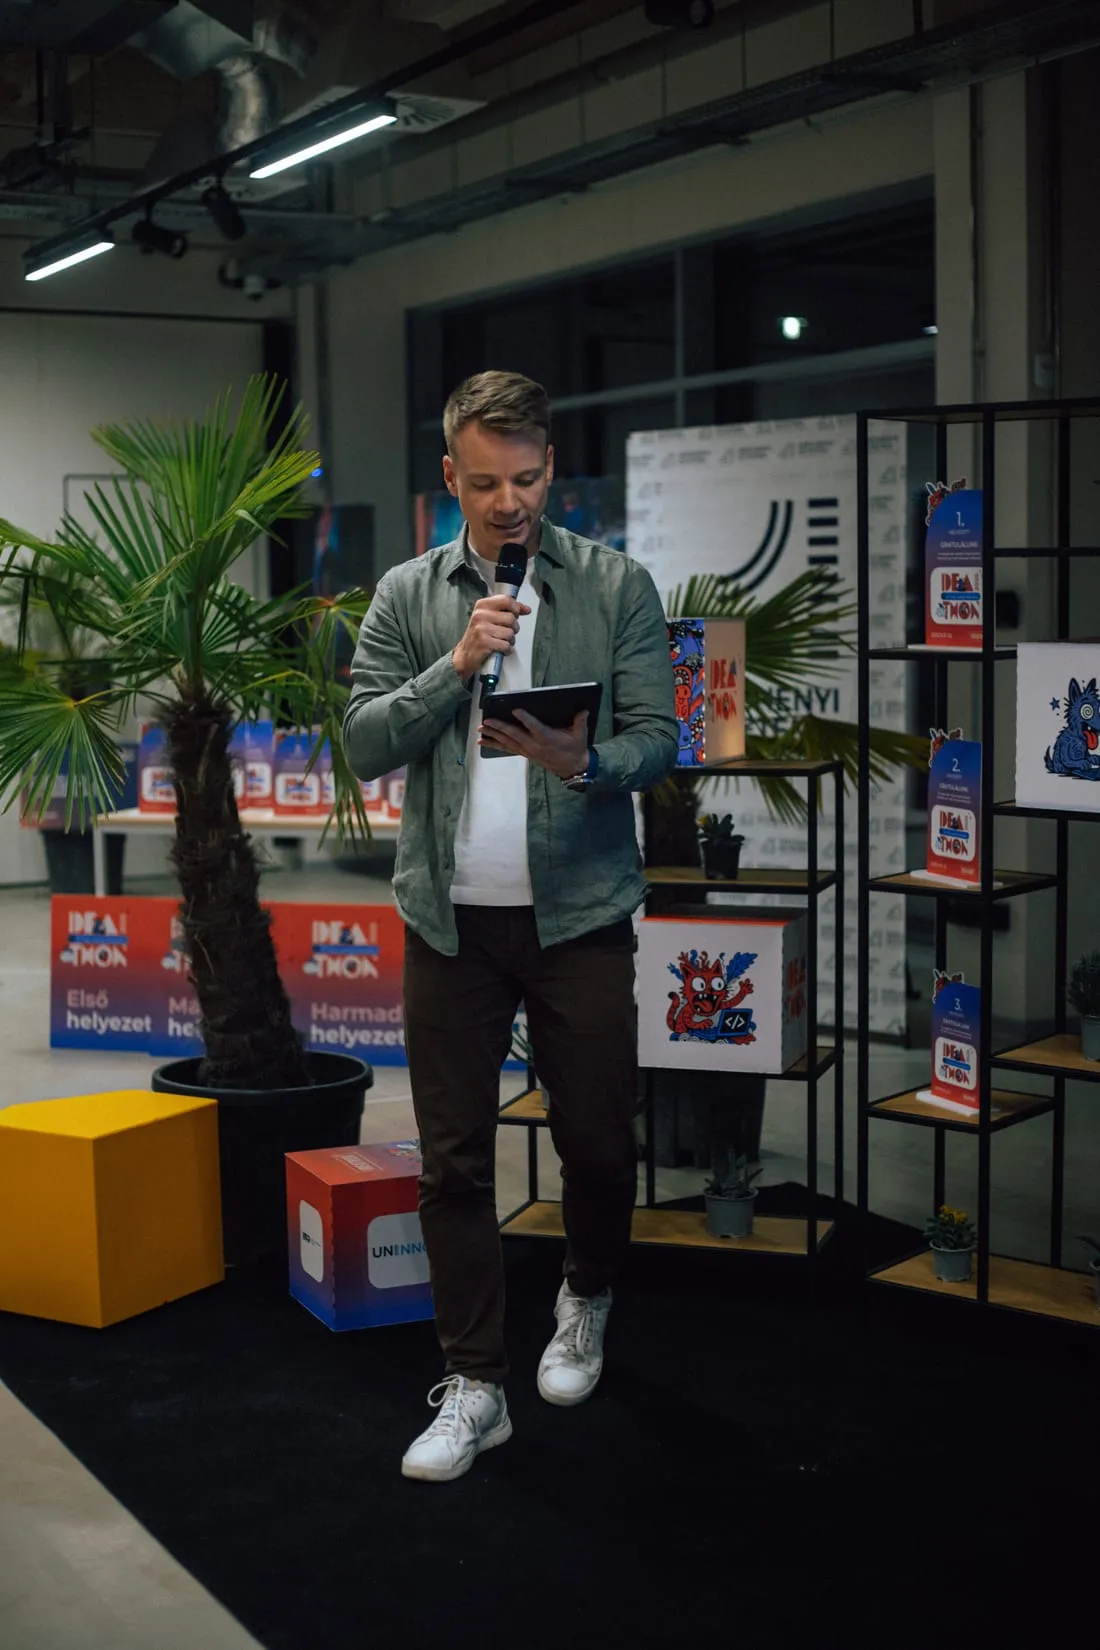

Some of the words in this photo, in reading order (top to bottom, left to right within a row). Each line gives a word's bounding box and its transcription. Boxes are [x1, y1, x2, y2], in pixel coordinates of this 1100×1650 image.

[956, 511, 965, 527] 1.
[941, 573, 973, 591] IDEA
[711, 657, 736, 690] IDEA
[66, 988, 109, 1009] Első
